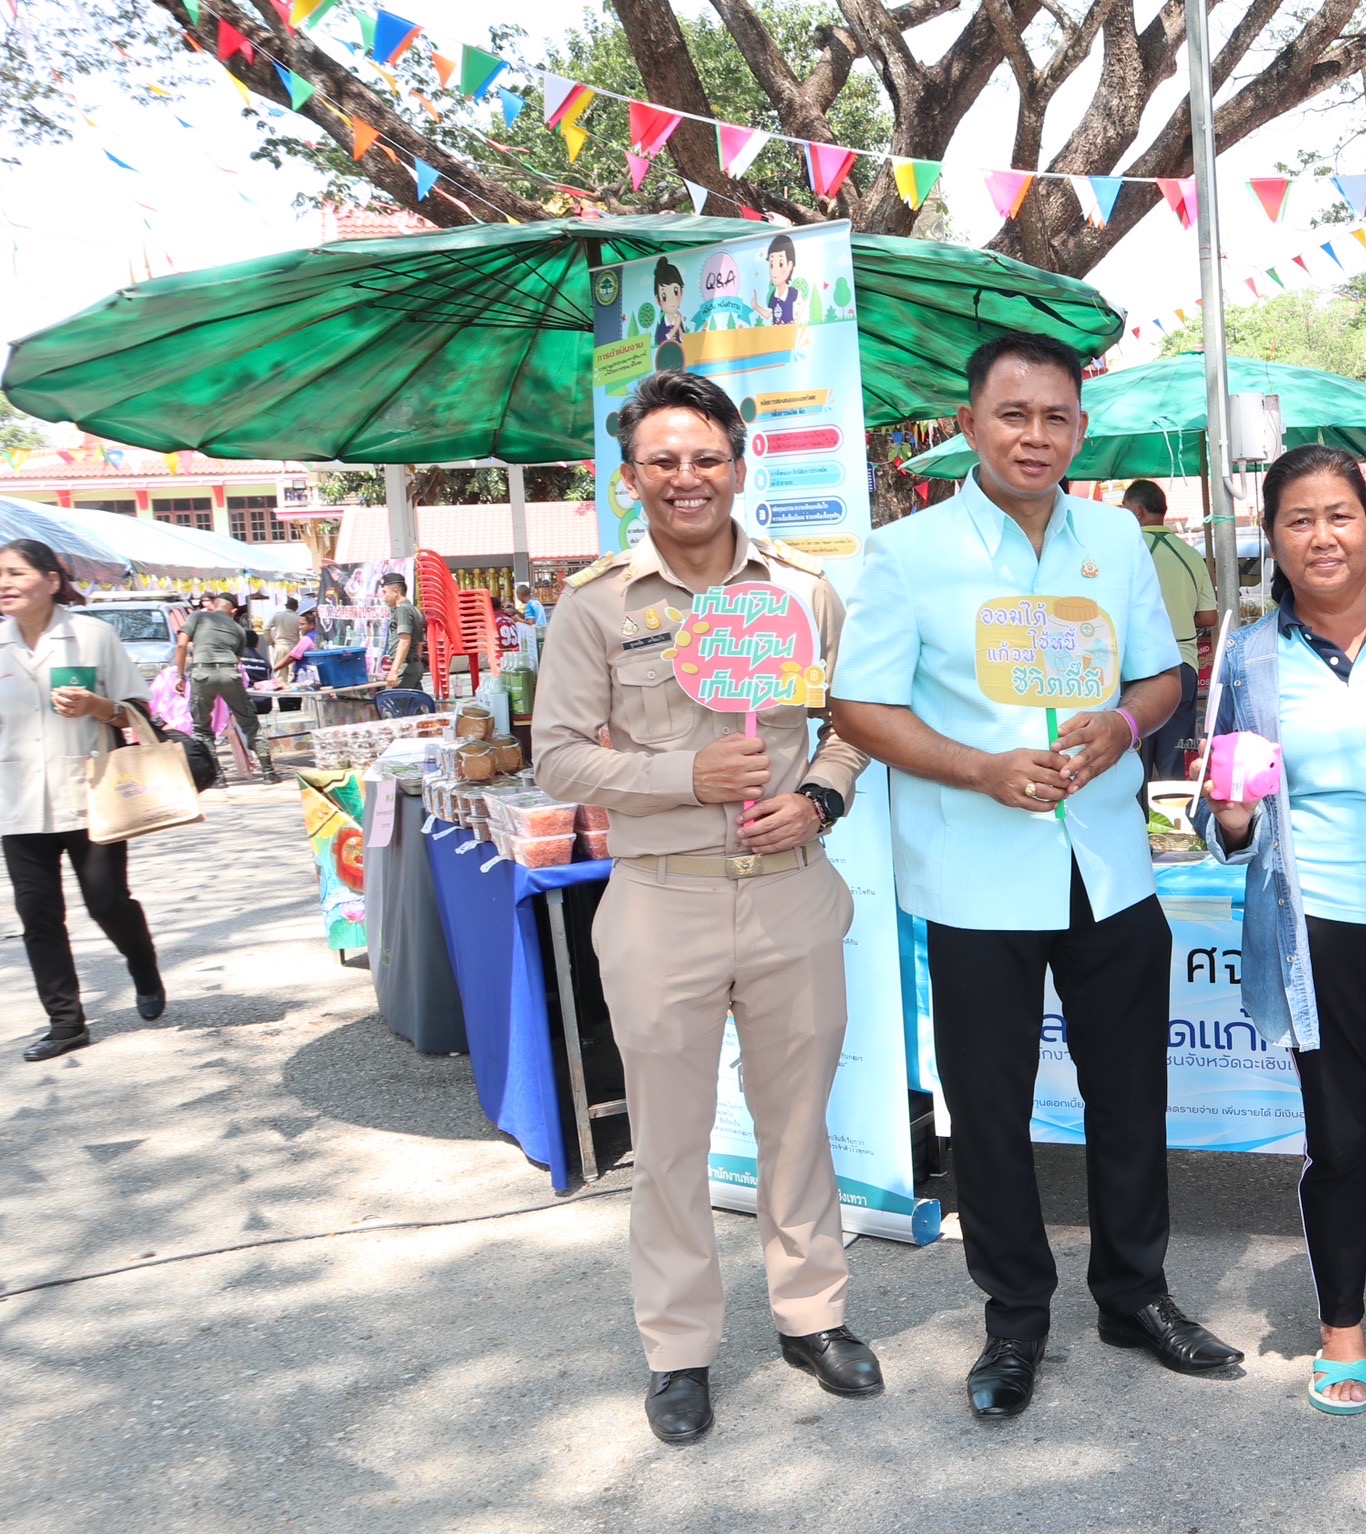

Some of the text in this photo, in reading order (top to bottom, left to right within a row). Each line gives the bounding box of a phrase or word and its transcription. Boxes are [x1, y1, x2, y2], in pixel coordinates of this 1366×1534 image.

[705, 270, 737, 291] Q&A
[692, 586, 791, 628] เก็บเงิน
[980, 602, 1047, 626] ออมได้
[698, 628, 796, 671] เก็บเงิน
[987, 642, 1036, 664] แก้จน
[698, 669, 796, 711] เก็บเงิน
[1167, 1053, 1293, 1071] ชนจังหวัดฉะเชิงเ
[1222, 1105, 1271, 1117] เพิ่มรายได้
